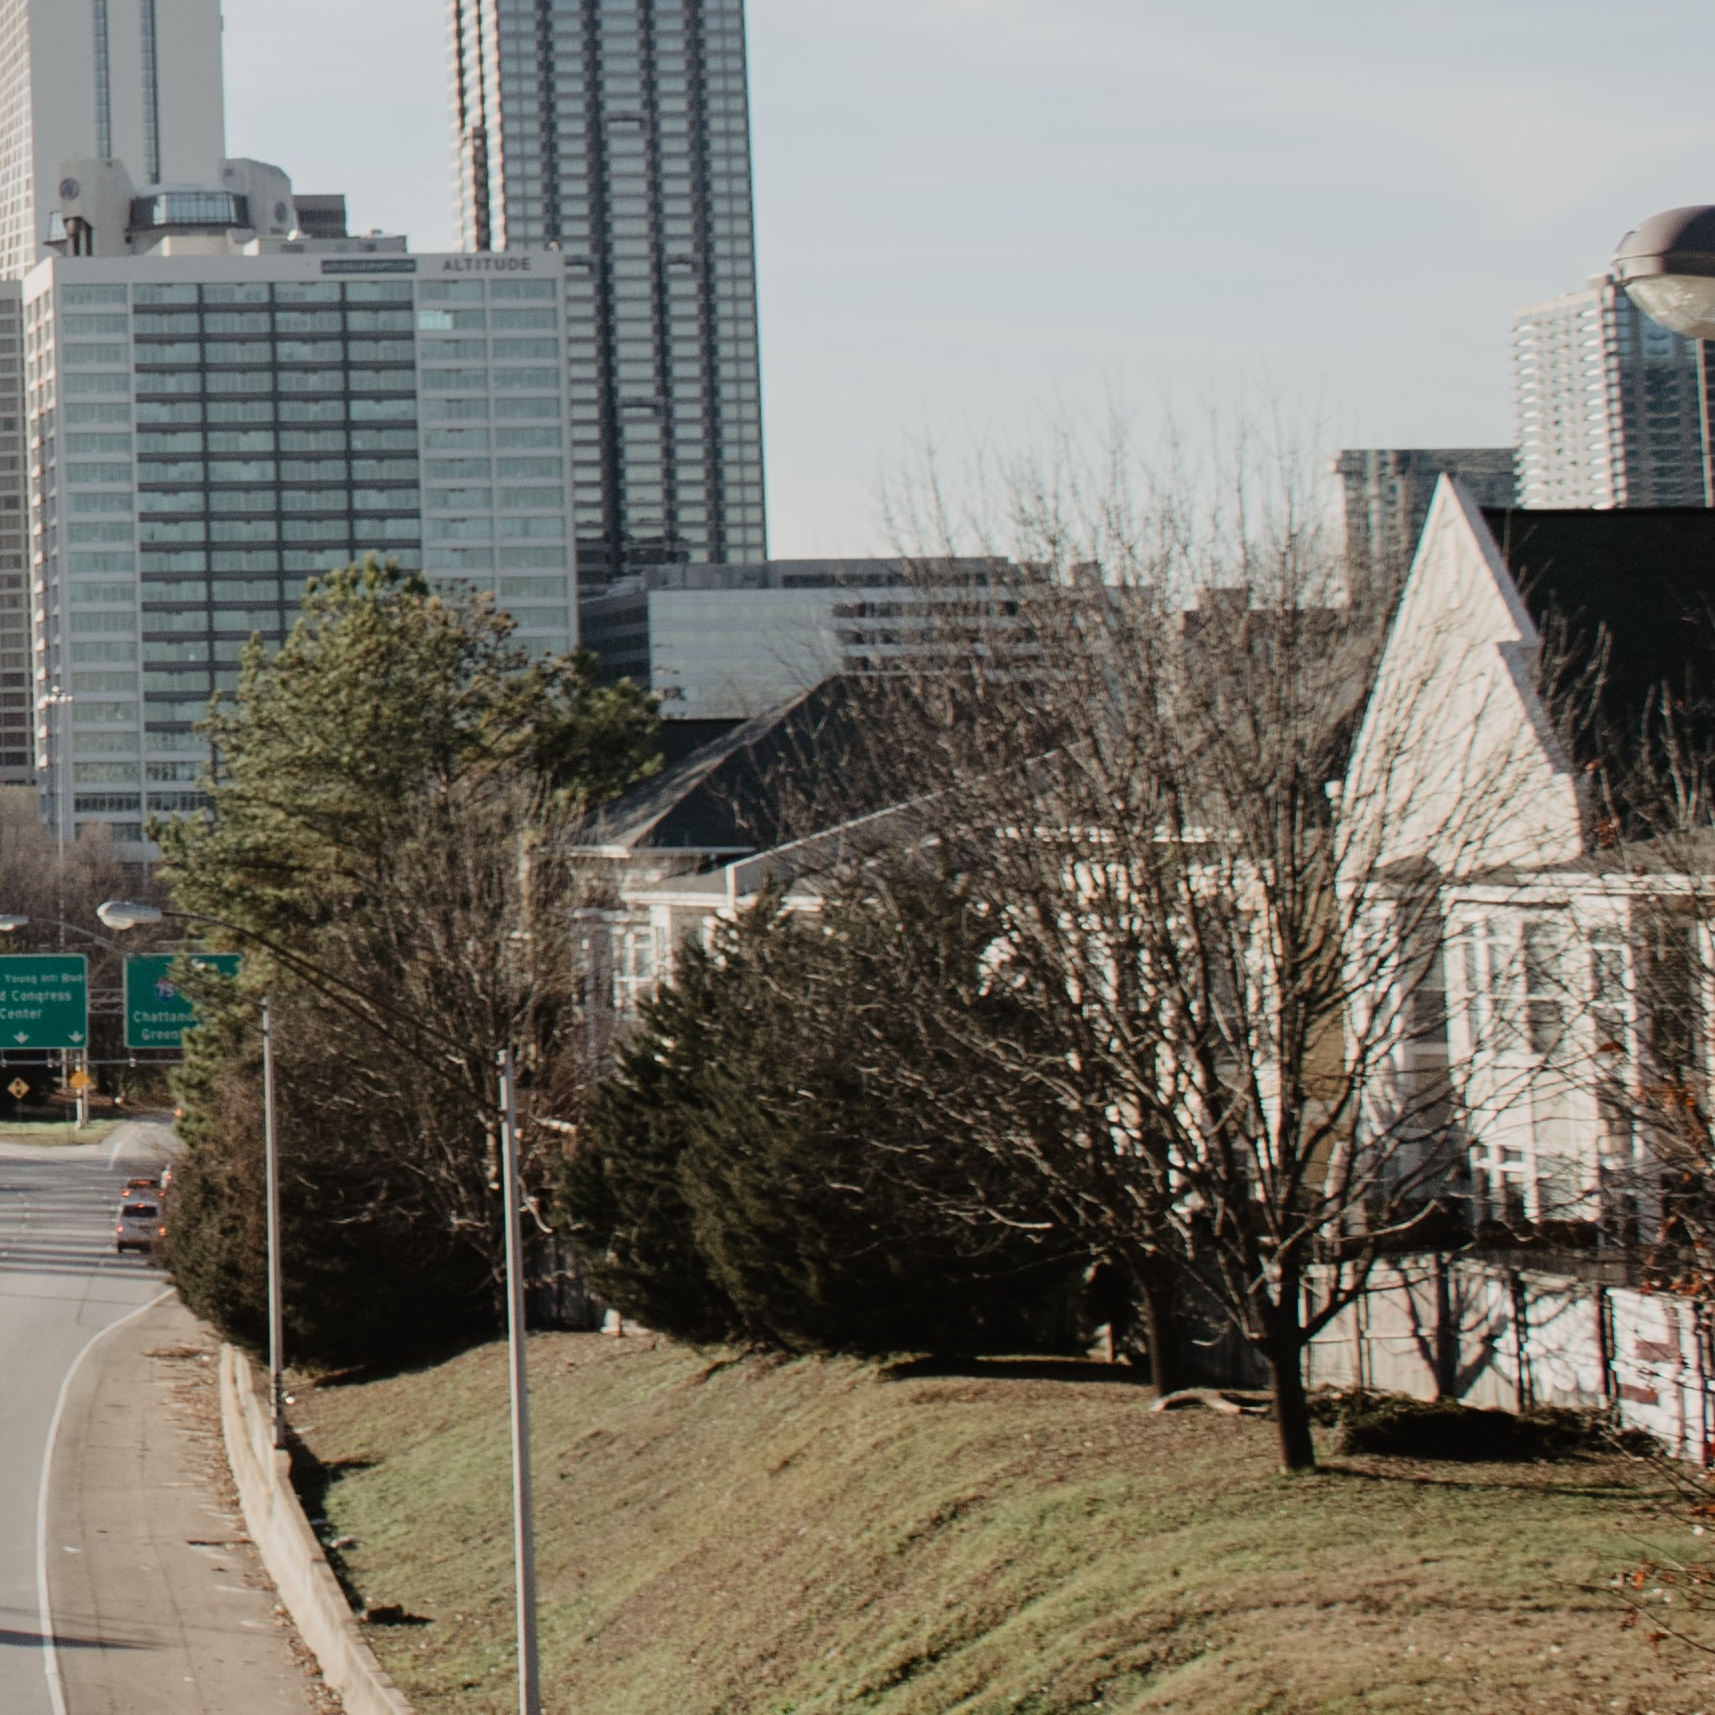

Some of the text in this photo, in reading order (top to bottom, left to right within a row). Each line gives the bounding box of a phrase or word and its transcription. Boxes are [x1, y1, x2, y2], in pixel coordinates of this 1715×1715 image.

[443, 257, 531, 271] ALTITUDE
[5, 974, 37, 984] Young
[11, 990, 72, 1003] Congress
[0, 1008, 43, 1020] Center
